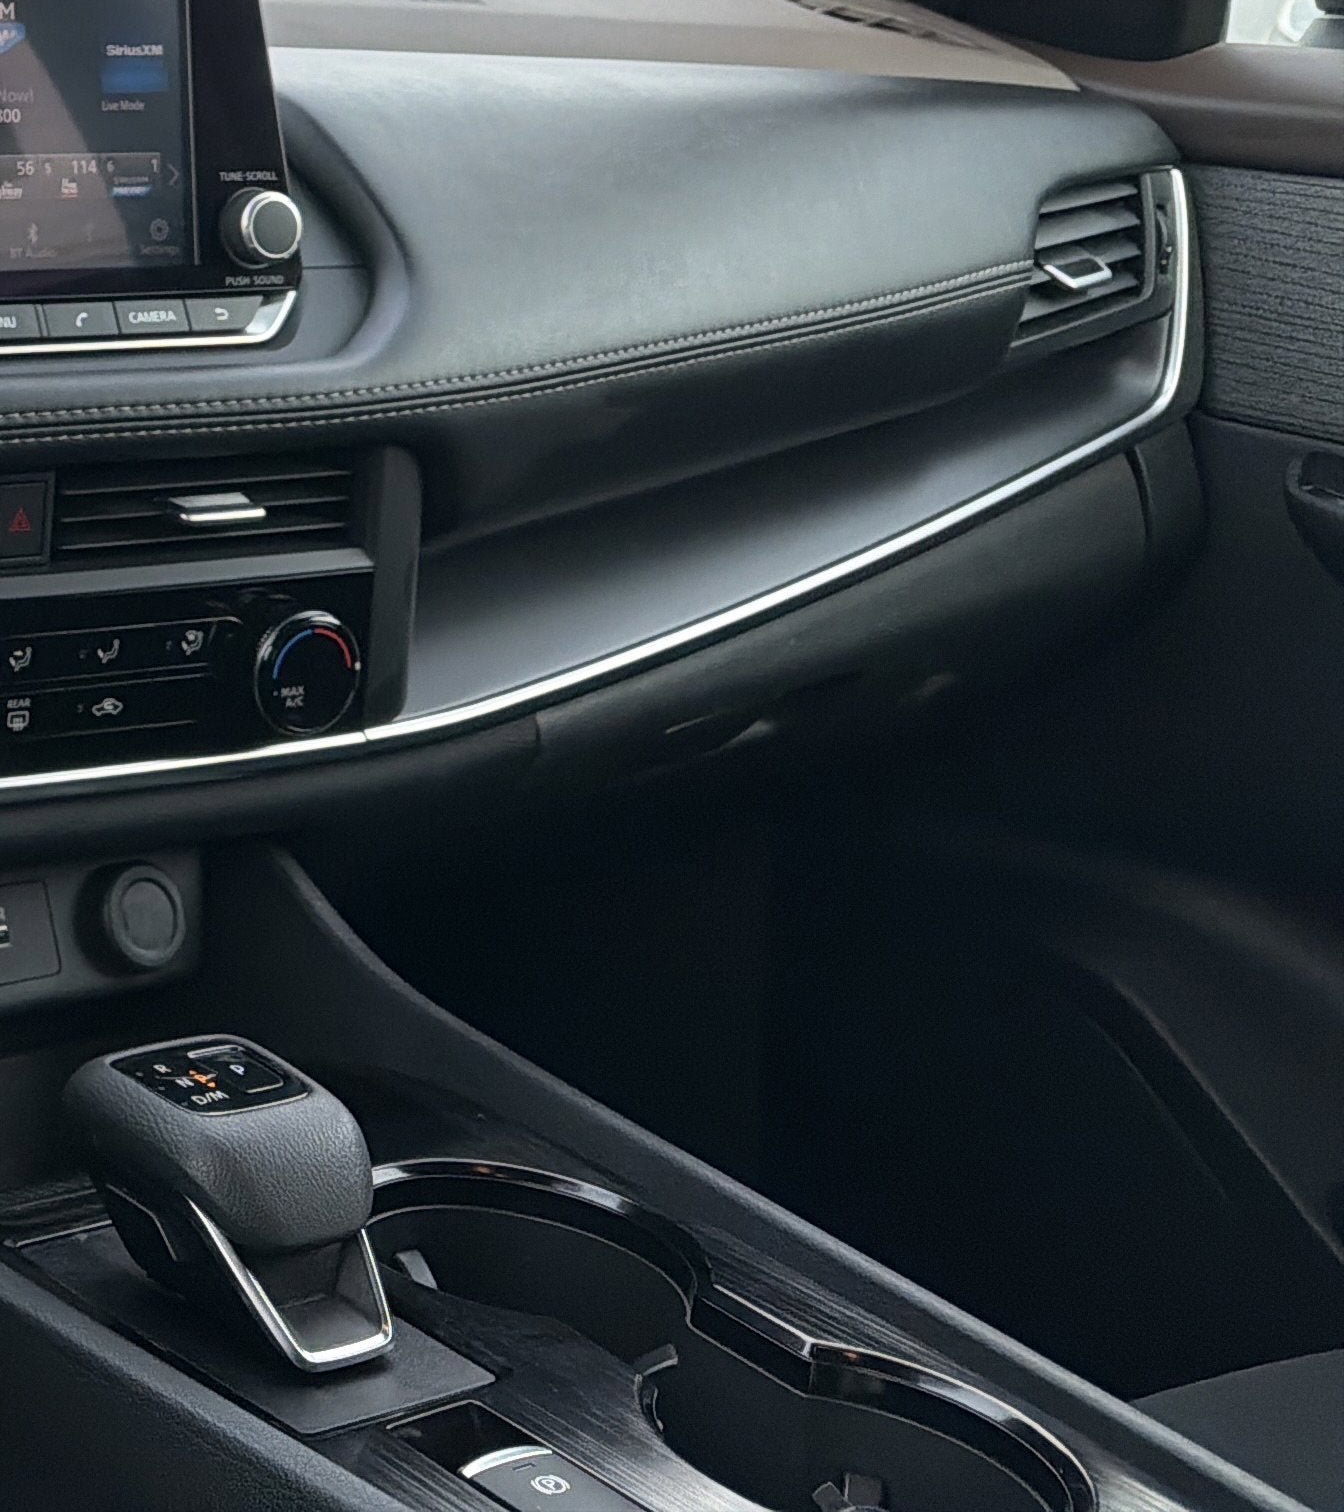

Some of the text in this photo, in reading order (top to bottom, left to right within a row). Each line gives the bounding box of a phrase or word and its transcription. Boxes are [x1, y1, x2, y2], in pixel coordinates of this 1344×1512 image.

[16, 160, 36, 176] 56
[71, 159, 98, 175] 114
[107, 161, 115, 173] 6
[150, 158, 159, 173] 1
[224, 274, 285, 287] PUSH SOUND
[128, 308, 177, 325] CAMERA
[280, 685, 305, 698] MAX
[7, 697, 31, 709] REAR
[152, 1063, 172, 1074] R
[228, 1063, 246, 1076] P
[190, 1090, 231, 1106] D/M
